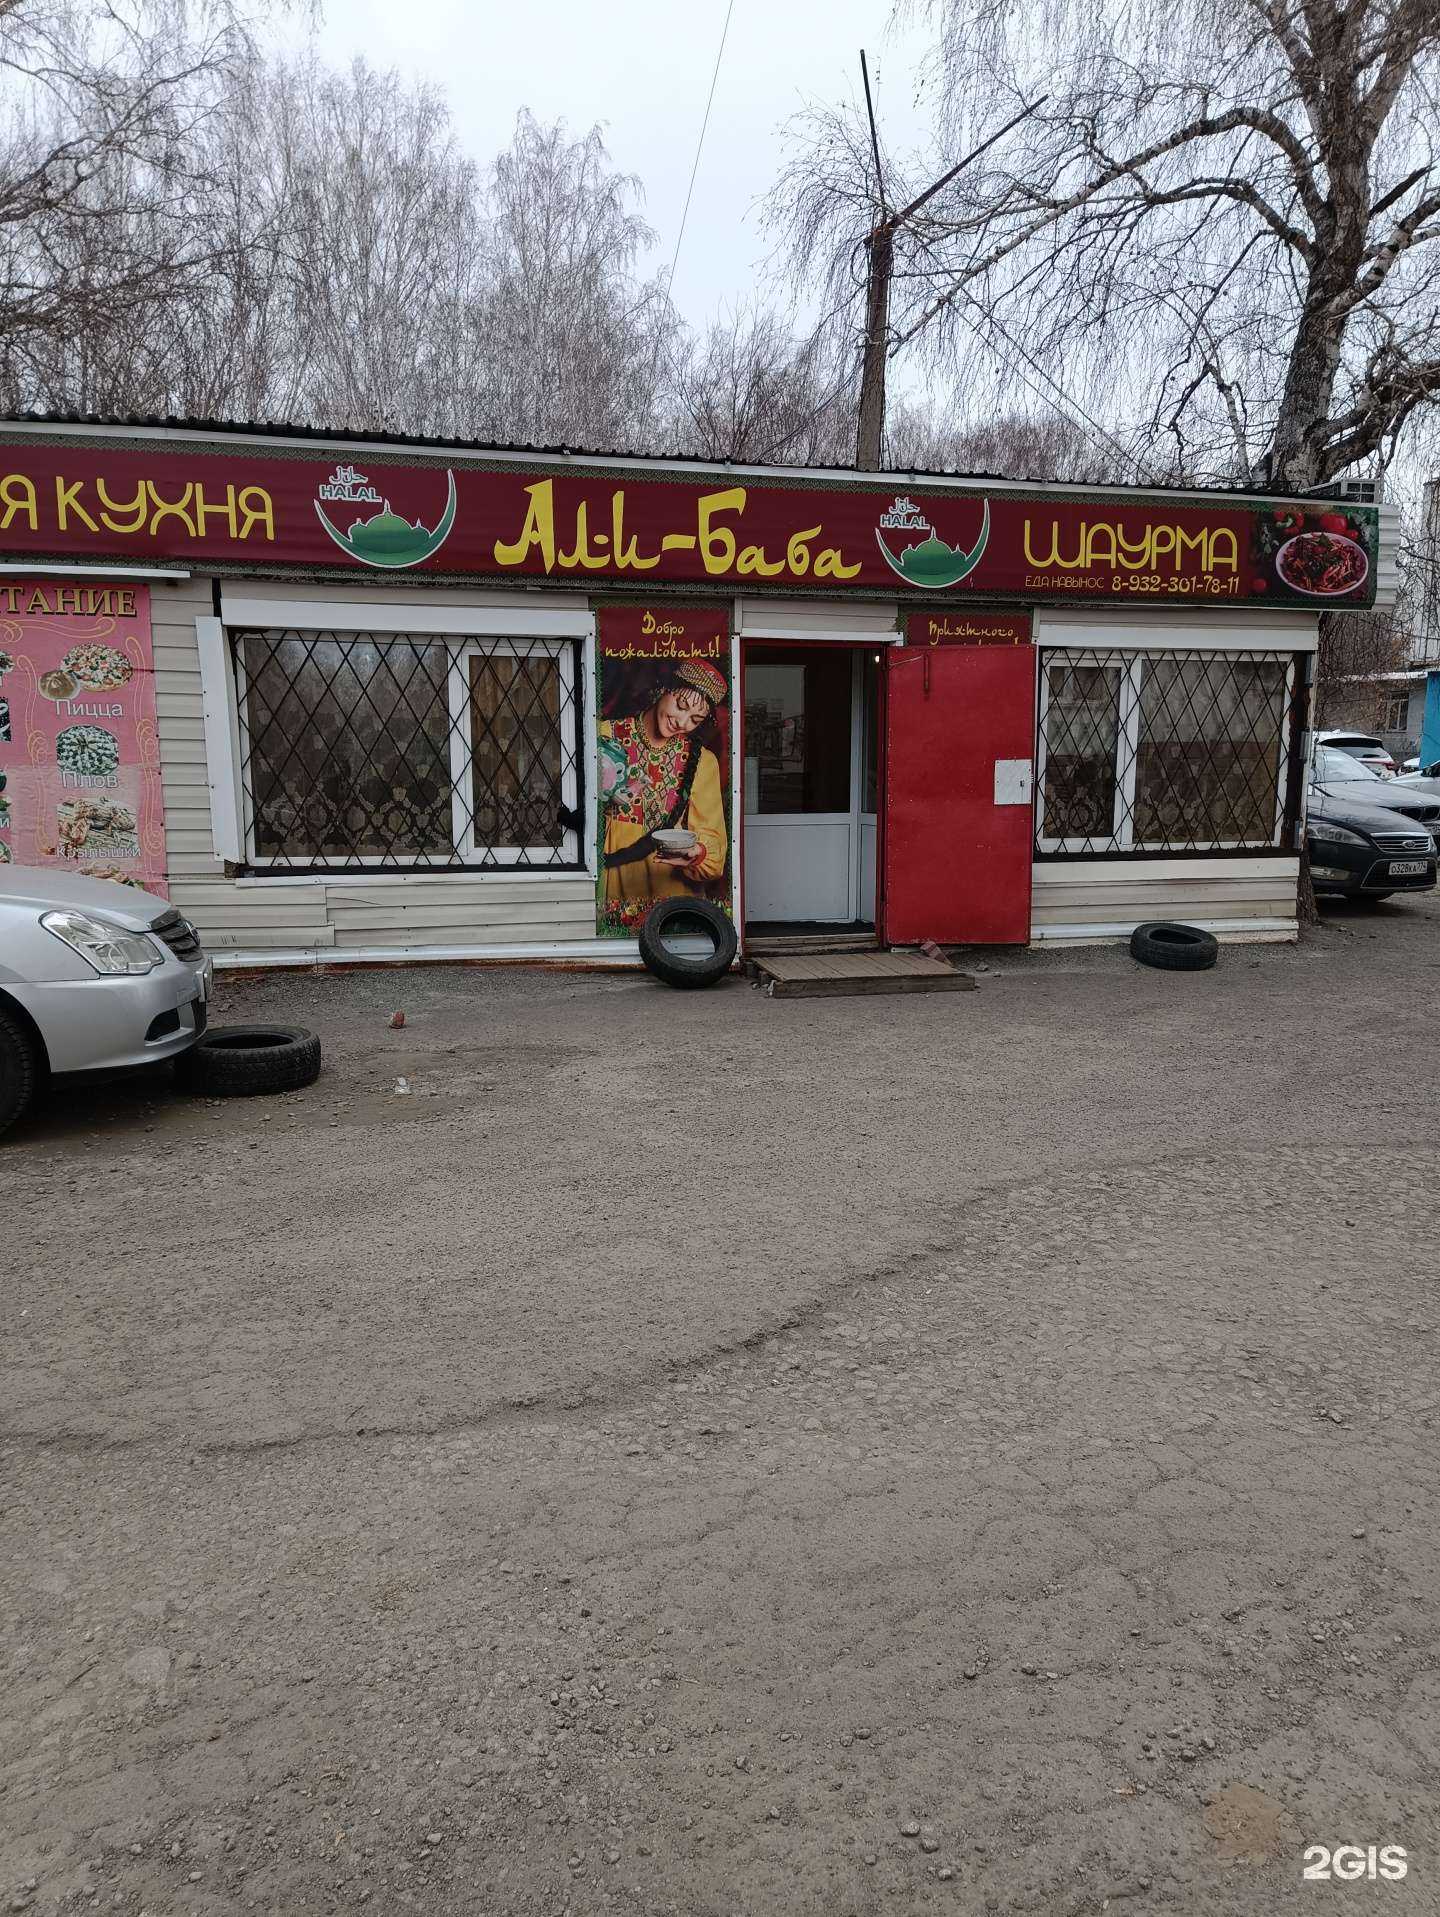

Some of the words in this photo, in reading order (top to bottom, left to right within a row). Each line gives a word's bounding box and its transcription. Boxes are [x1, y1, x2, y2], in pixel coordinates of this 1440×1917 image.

[319, 484, 382, 502] HALAL
[56, 476, 275, 540] КУХНЯ
[493, 478, 863, 578] Али-Баба
[880, 513, 930, 530] HALAL
[1024, 519, 1238, 573] ШАУРМА
[1025, 575, 1049, 588] ЕДА
[1111, 575, 1239, 594] 8-932-301-78-11
[641, 610, 685, 646] Добро
[605, 634, 720, 660] пожаловать!
[55, 698, 124, 719] Пицца
[61, 769, 119, 788] Плов
[55, 845, 142, 861] Крылышки
